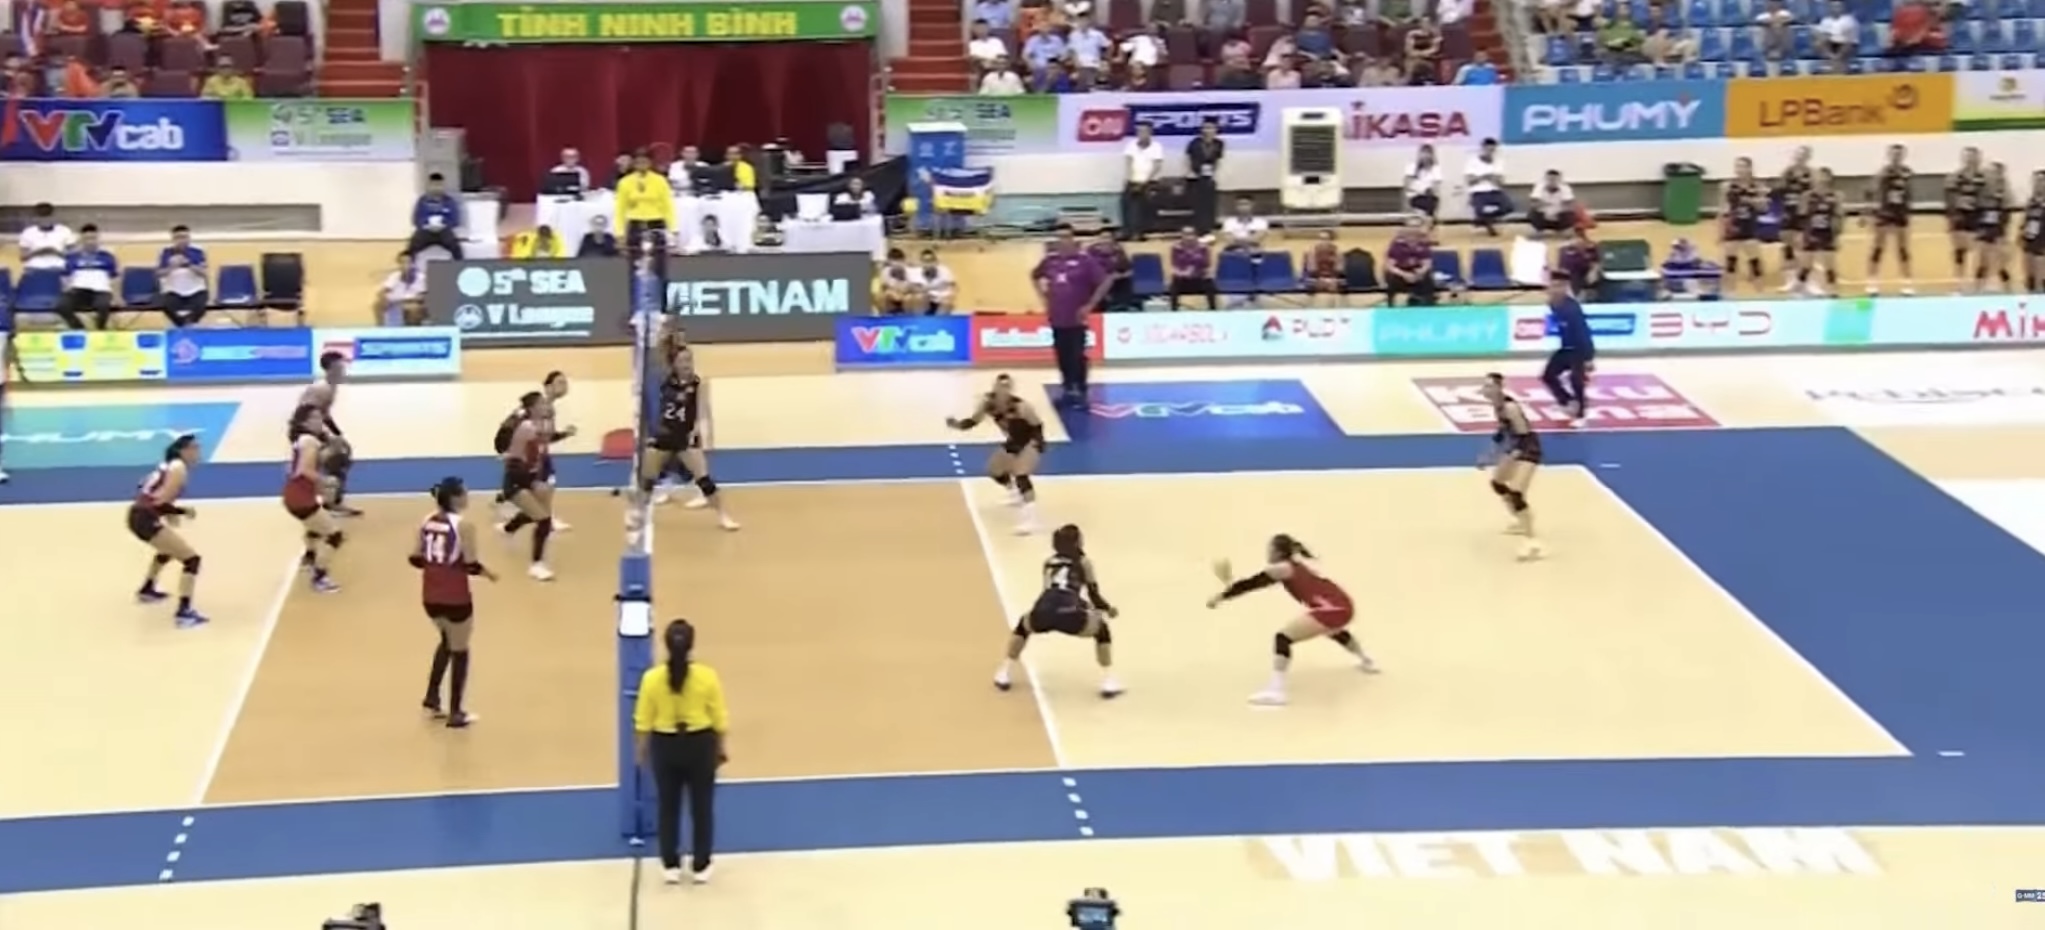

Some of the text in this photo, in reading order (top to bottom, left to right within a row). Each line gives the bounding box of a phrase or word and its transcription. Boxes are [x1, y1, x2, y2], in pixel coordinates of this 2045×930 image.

[600, 12, 694, 36] NINH
[1343, 101, 1470, 140] iKASA
[1521, 99, 1702, 133] PHUMY
[1759, 98, 1887, 128] LPBank
[20, 109, 185, 151] VTVcab
[530, 269, 587, 294] SEA
[664, 402, 687, 422] 24
[424, 532, 447, 564] 14
